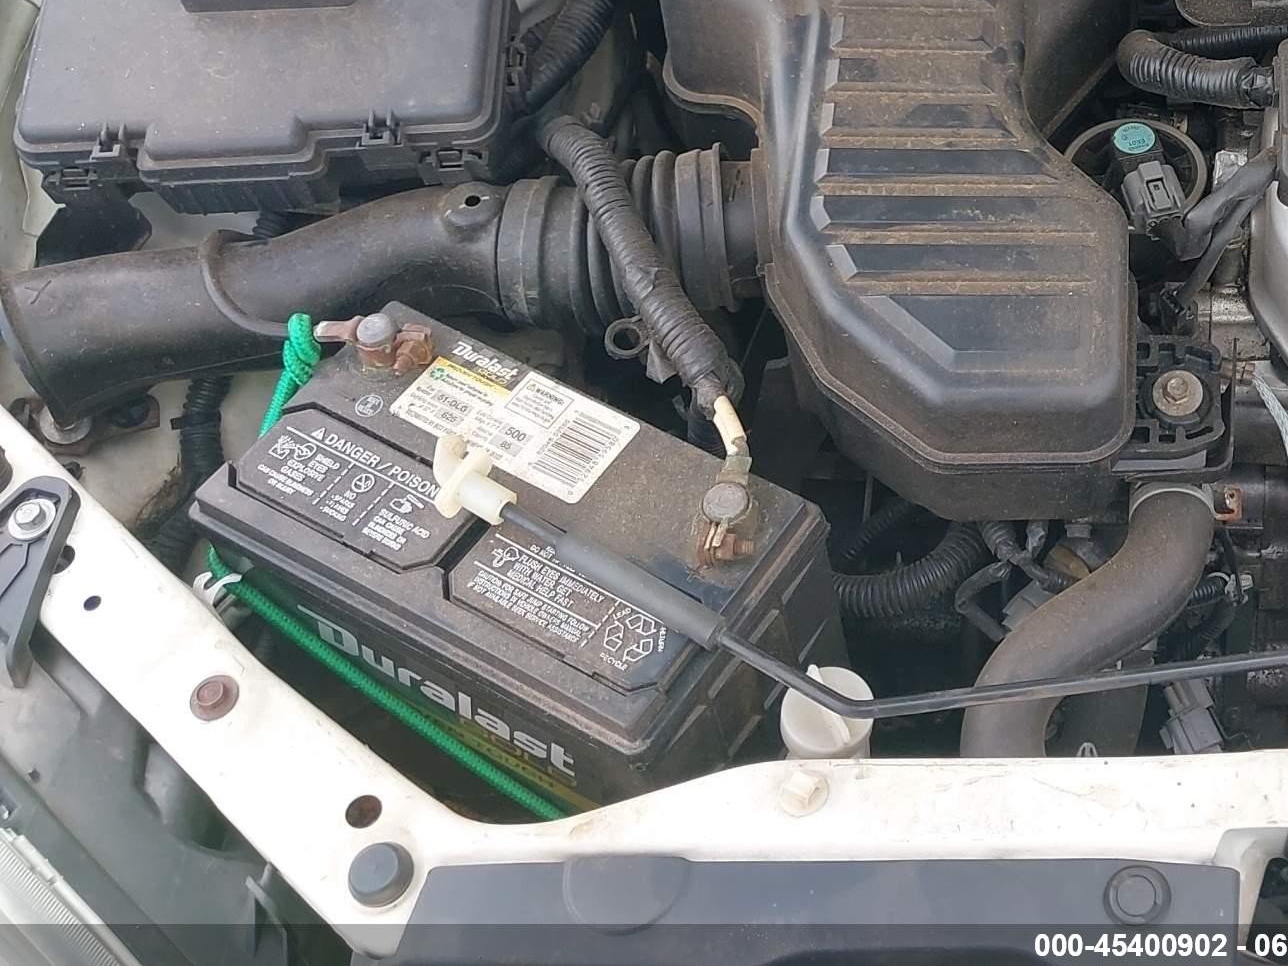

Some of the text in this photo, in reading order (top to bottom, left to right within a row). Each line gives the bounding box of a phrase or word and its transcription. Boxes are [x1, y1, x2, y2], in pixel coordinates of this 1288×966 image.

[451, 341, 519, 379] Duralast
[440, 411, 458, 423] 625
[504, 427, 527, 442] 500
[280, 466, 304, 482] GASES
[287, 458, 326, 483] EXPLOSIVE
[308, 460, 329, 473] EYES
[314, 454, 341, 470] SHIELD
[324, 433, 381, 469] DANGER
[388, 464, 439, 498] POISON
[344, 490, 357, 500] NO
[380, 509, 431, 539] SULFURIC ACID
[506, 569, 536, 591] MEDICAL
[535, 583, 556, 599] HELP
[514, 563, 531, 577] WITH
[556, 583, 572, 596] GET
[520, 555, 543, 572] FLUSH
[541, 565, 561, 579] EYES
[559, 575, 605, 603] IMMEDIATELY
[501, 580, 517, 594] FOR
[514, 585, 529, 600] SAFE
[542, 599, 570, 619] STARTING
[612, 607, 632, 620] LEAD
[599, 653, 628, 672] RECYCLE
[296, 603, 577, 778] Duralast
